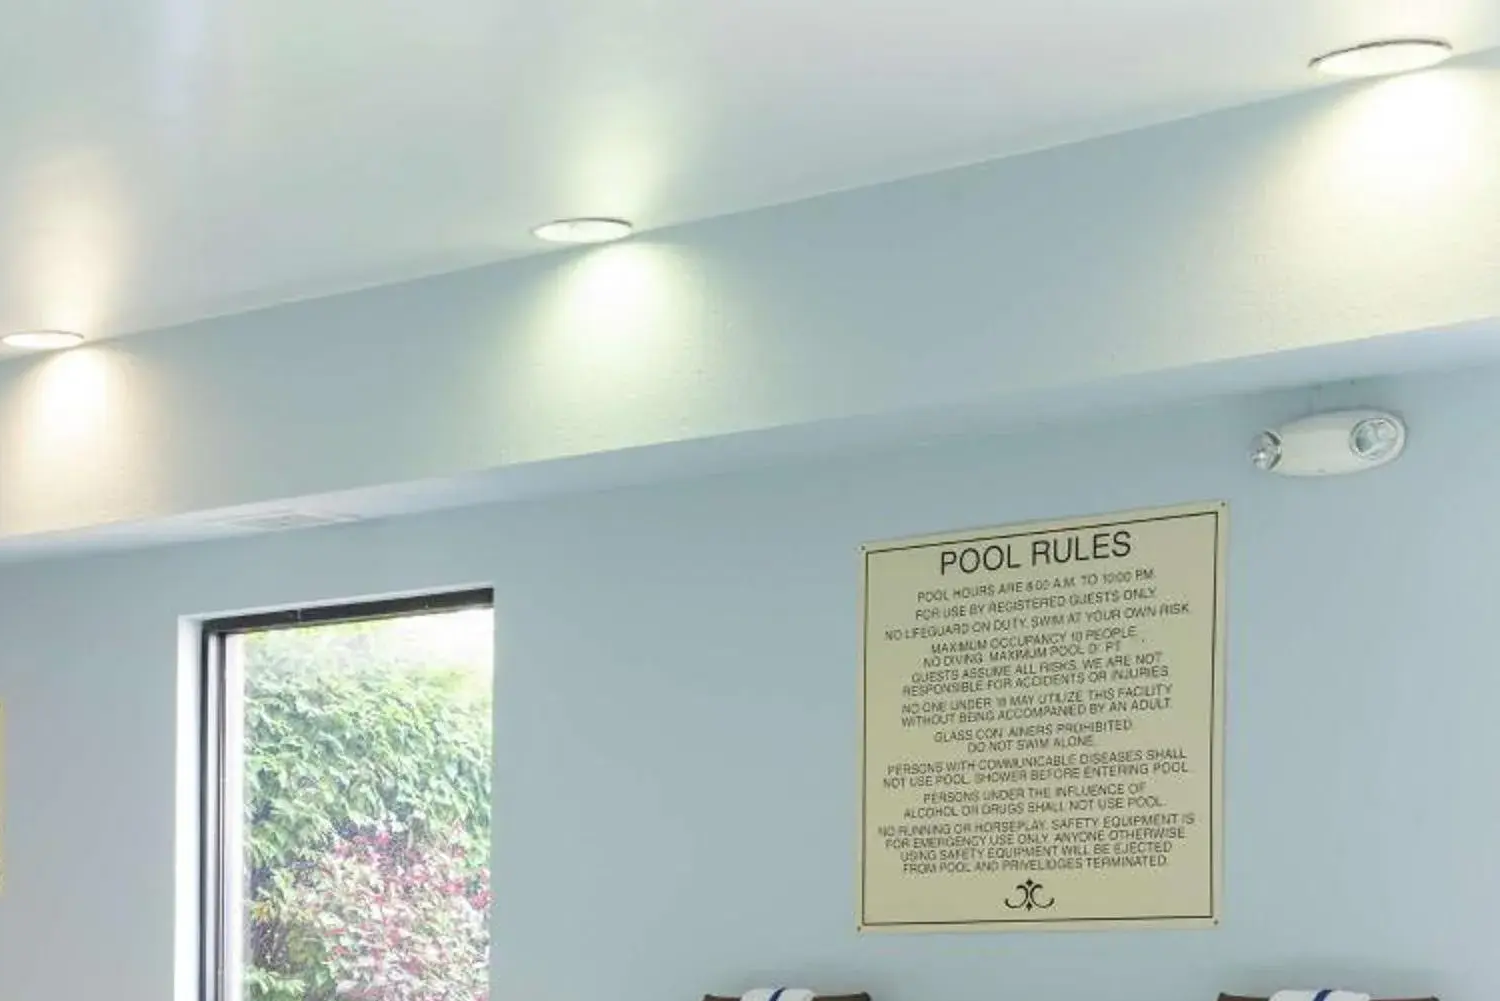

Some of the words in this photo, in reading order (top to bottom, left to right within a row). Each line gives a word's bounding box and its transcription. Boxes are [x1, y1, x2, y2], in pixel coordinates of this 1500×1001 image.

[941, 544, 1021, 576] POOL
[1032, 530, 1131, 566] RULES
[917, 588, 949, 603] POOL
[952, 583, 995, 600] HOURS
[997, 580, 1022, 595] ARE
[1080, 572, 1098, 586] TO
[915, 606, 940, 621] FOR
[942, 604, 966, 618] USE
[968, 602, 985, 616] BY
[987, 594, 1065, 614] REGISTERED
[1069, 588, 1119, 606] GUESTS
[884, 628, 902, 641] NO
[905, 621, 969, 639] LIFEGUARD
[971, 619, 991, 633] ON
[1030, 612, 1064, 628] SWIM
[1067, 611, 1081, 624] AT
[1085, 607, 1121, 622] YOUR
[1123, 603, 1156, 619] OWN
[922, 655, 941, 668] NO
[989, 645, 1046, 662] MAXIMUM
[1049, 642, 1085, 657] POOL
[931, 638, 987, 655] MAXIMUM
[989, 631, 1066, 649] OCCUPANCY
[911, 668, 959, 684] GUESTS
[961, 664, 1011, 680] ASSUME
[1014, 662, 1036, 675] ALL
[1081, 656, 1102, 670] WE
[1106, 653, 1130, 668] ARE
[1135, 651, 1162, 665] NOT
[902, 679, 983, 697] RESPONSIBLE
[987, 676, 1012, 691] FOR
[1013, 670, 1085, 689] ACCIDENTS
[1087, 669, 1106, 683] OR
[901, 702, 920, 715] NO
[950, 696, 991, 711] UNDER
[1009, 693, 1034, 707] MAY
[1088, 687, 1114, 701] THIS
[1117, 682, 1173, 699] FACILITY
[901, 712, 956, 728] WITHOUT
[1089, 701, 1105, 714] BY
[1108, 699, 1127, 713] AN
[933, 728, 972, 743] GLASS
[966, 741, 986, 754] DO
[988, 739, 1013, 753] NOT
[887, 761, 943, 776] PERSONS
[945, 759, 975, 773] WITH
[1145, 746, 1188, 761] SHALL
[883, 776, 905, 789] NOT
[909, 774, 933, 788] USE
[975, 769, 1026, 784] SHOWER
[1082, 762, 1148, 778] ENTERING
[982, 787, 1024, 801] UNDER
[1027, 786, 1050, 799] THE
[1055, 782, 1124, 798] INFLUENCE
[980, 801, 1024, 816] DRUGS
[1069, 798, 1093, 811] NOT
[1097, 796, 1124, 810] USE
[1050, 816, 1099, 830] SAFETY
[884, 837, 909, 850] FOR
[988, 833, 1015, 846] USE
[1054, 829, 1105, 843] ANYONE
[899, 849, 936, 862] USING
[1061, 843, 1091, 856] WILL
[1092, 842, 1111, 855] BE
[1113, 839, 1172, 854] EJECTED
